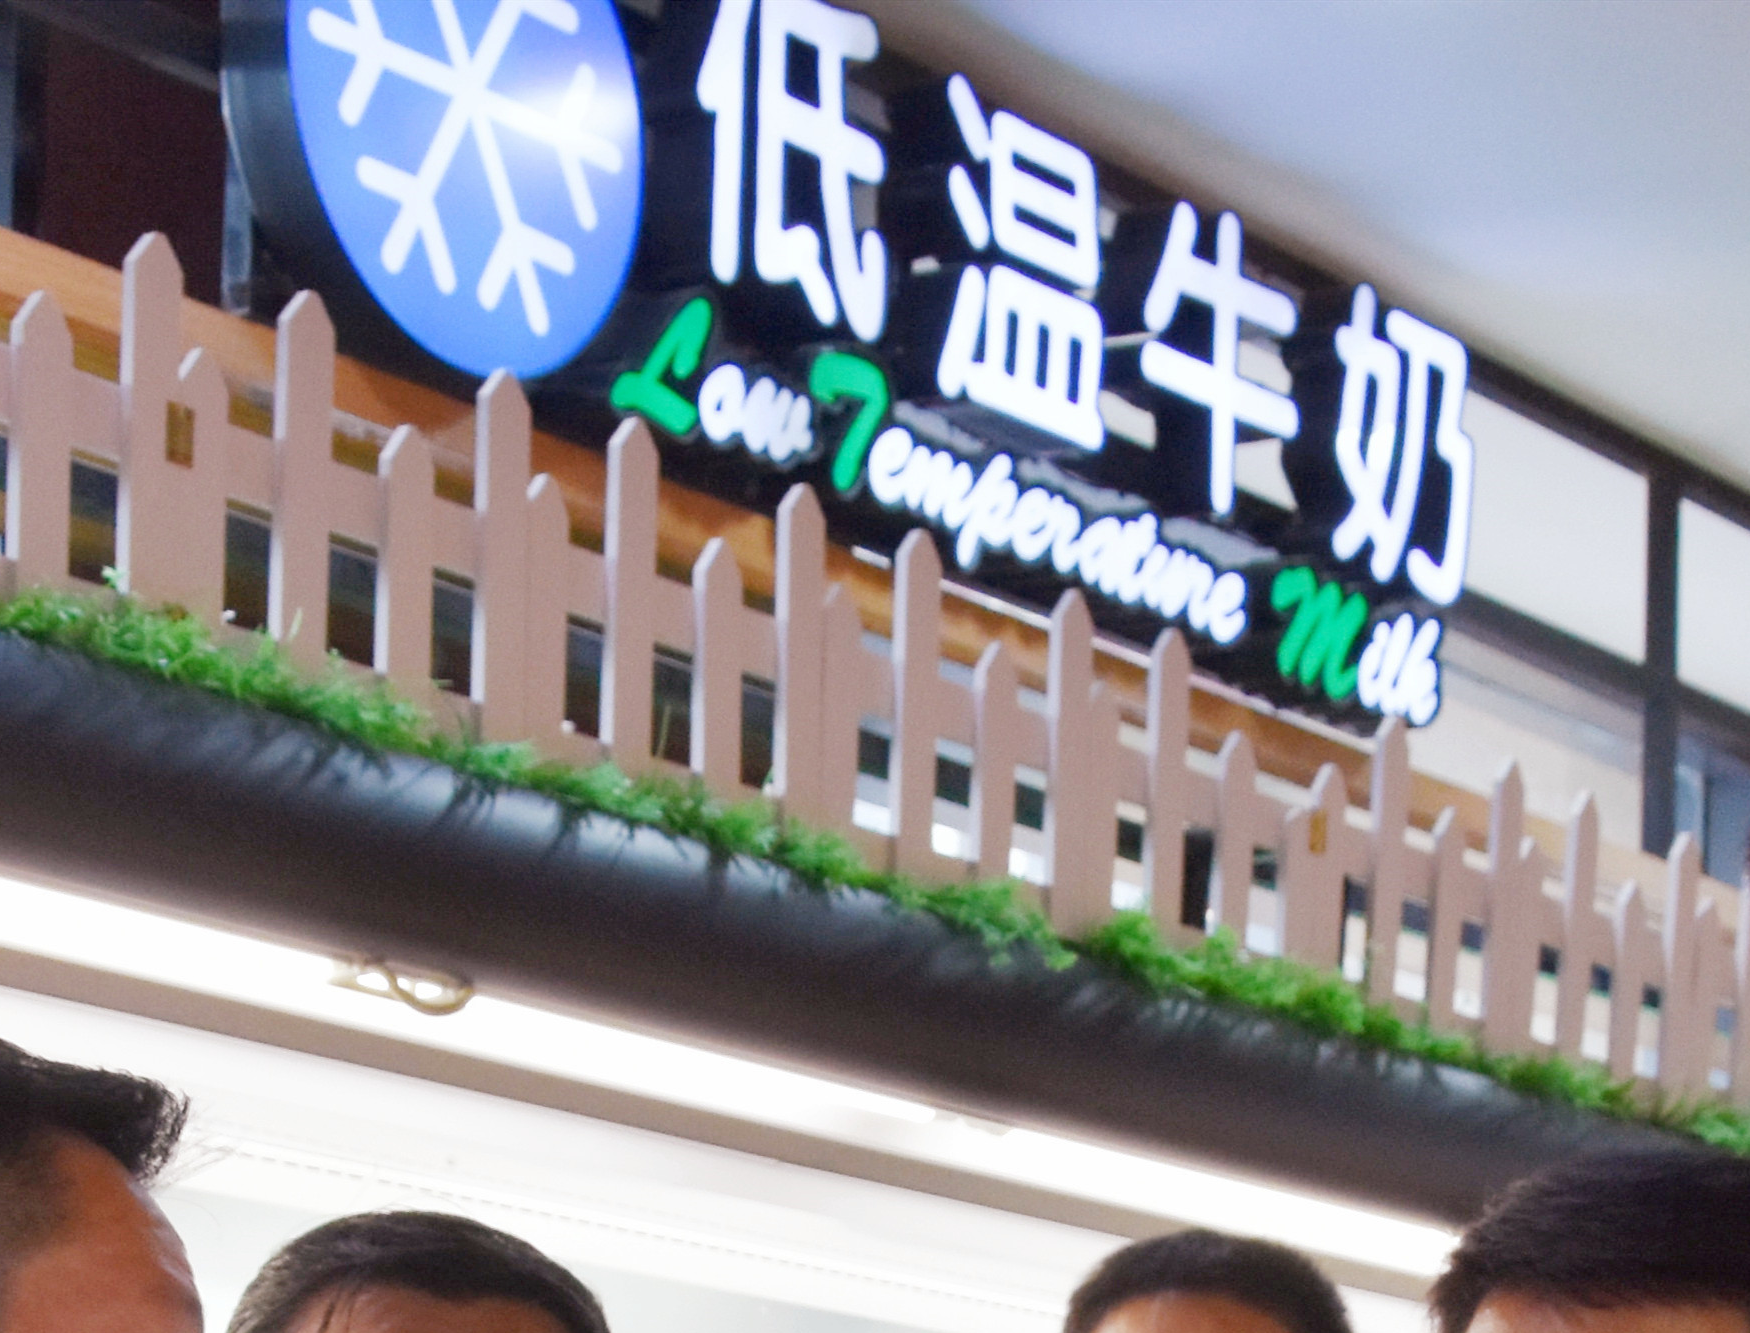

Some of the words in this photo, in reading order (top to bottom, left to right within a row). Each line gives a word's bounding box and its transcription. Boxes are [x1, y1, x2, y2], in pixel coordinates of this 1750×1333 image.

[697, 0, 1472, 604] 低温牛奶
[809, 353, 1246, 645] Temperature
[1271, 566, 1441, 726] Milk
